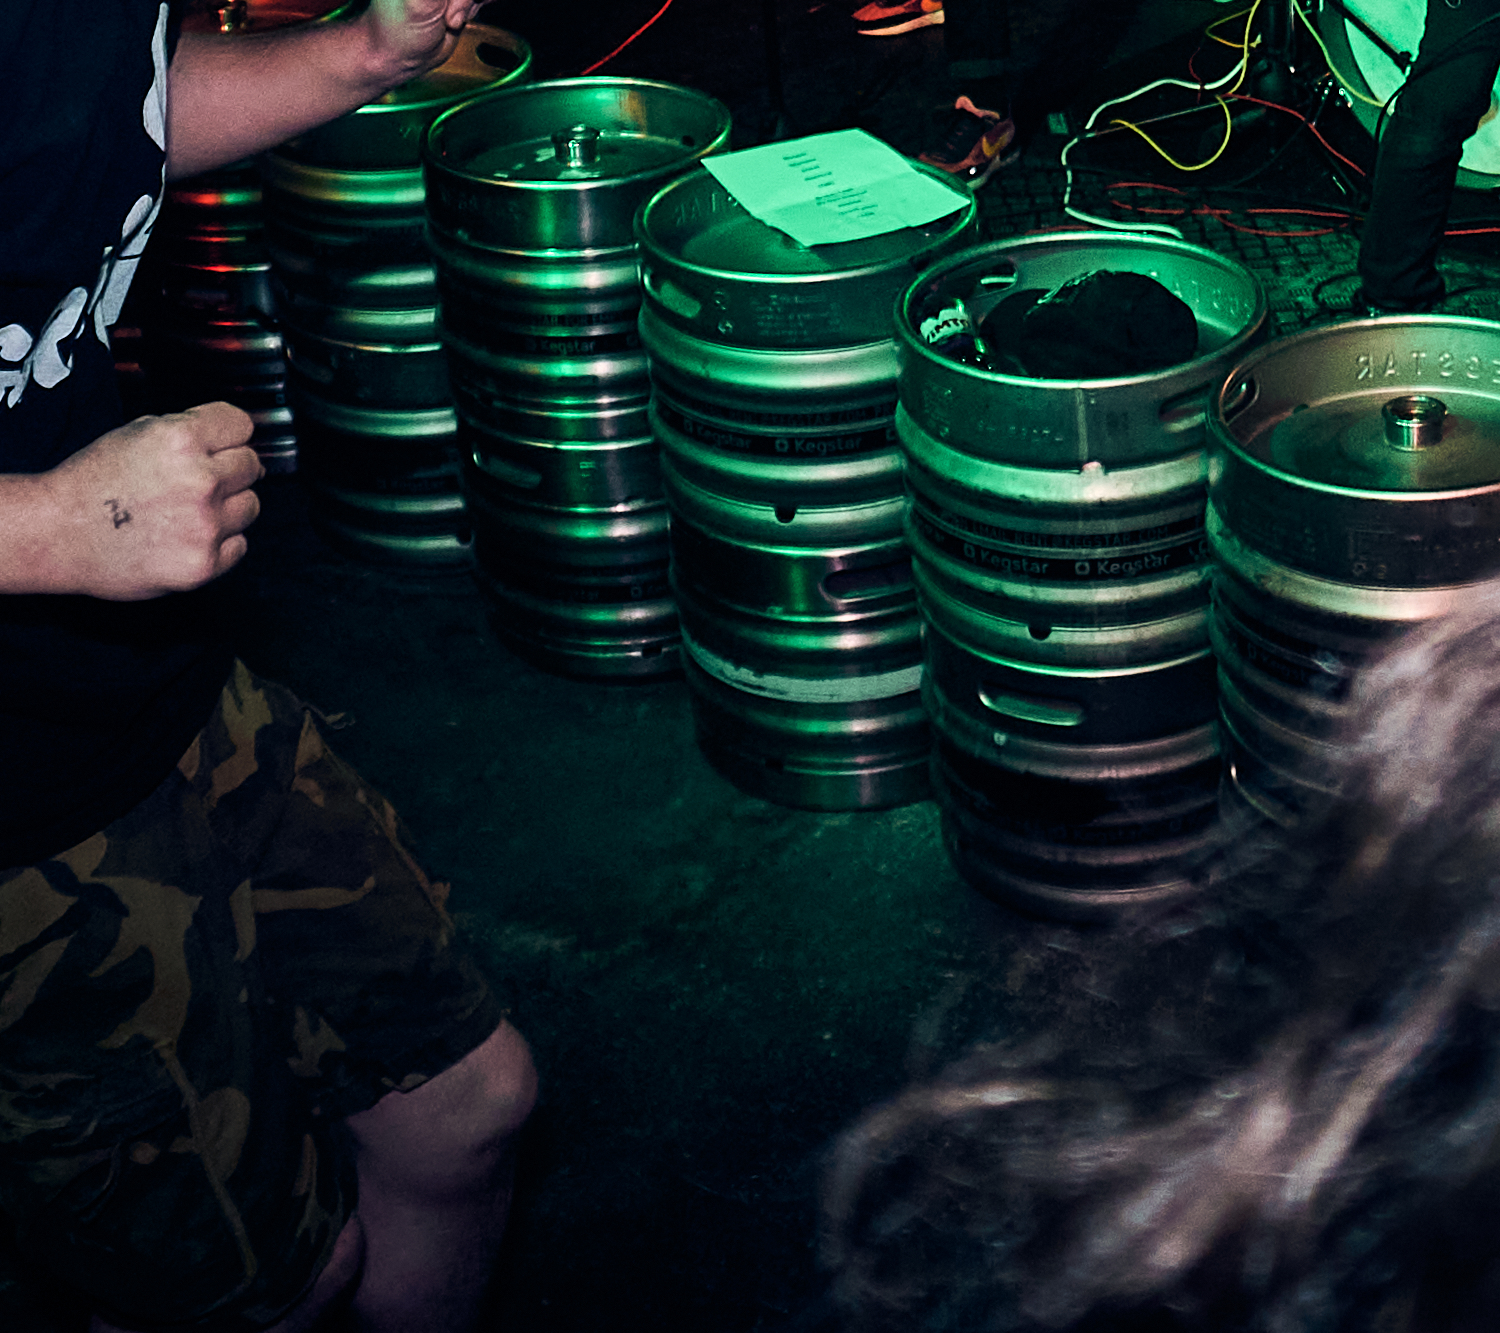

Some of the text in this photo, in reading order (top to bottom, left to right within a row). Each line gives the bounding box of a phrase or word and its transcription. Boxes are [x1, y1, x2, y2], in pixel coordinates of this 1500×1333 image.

[540, 338, 595, 357] Kegstar
[794, 435, 863, 456] Kegstar
[980, 547, 1171, 575] Kegstar Kegstar
